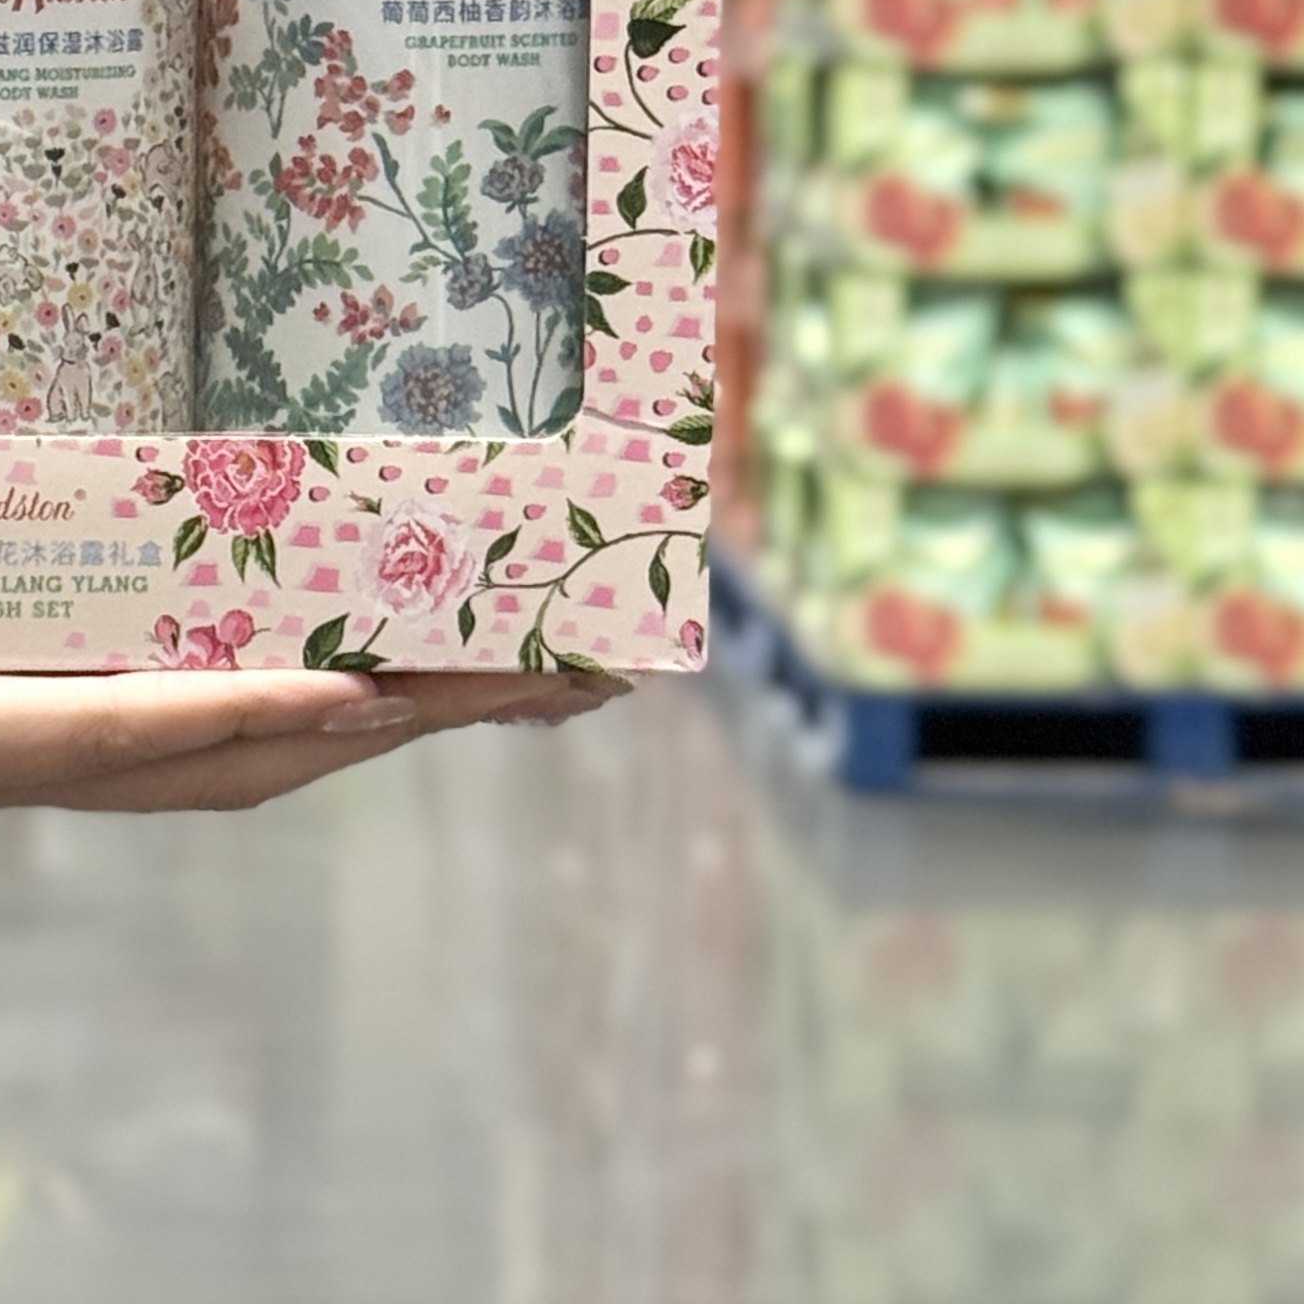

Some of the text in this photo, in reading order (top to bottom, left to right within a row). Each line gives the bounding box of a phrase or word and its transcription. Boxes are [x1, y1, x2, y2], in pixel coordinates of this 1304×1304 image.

[404, 32, 578, 50] GRAPEFRUIT SCENTED
[447, 53, 541, 68] BODY WASH
[36, 86, 79, 100] WASH
[71, 576, 149, 593] YLANG
[31, 601, 75, 618] SET
